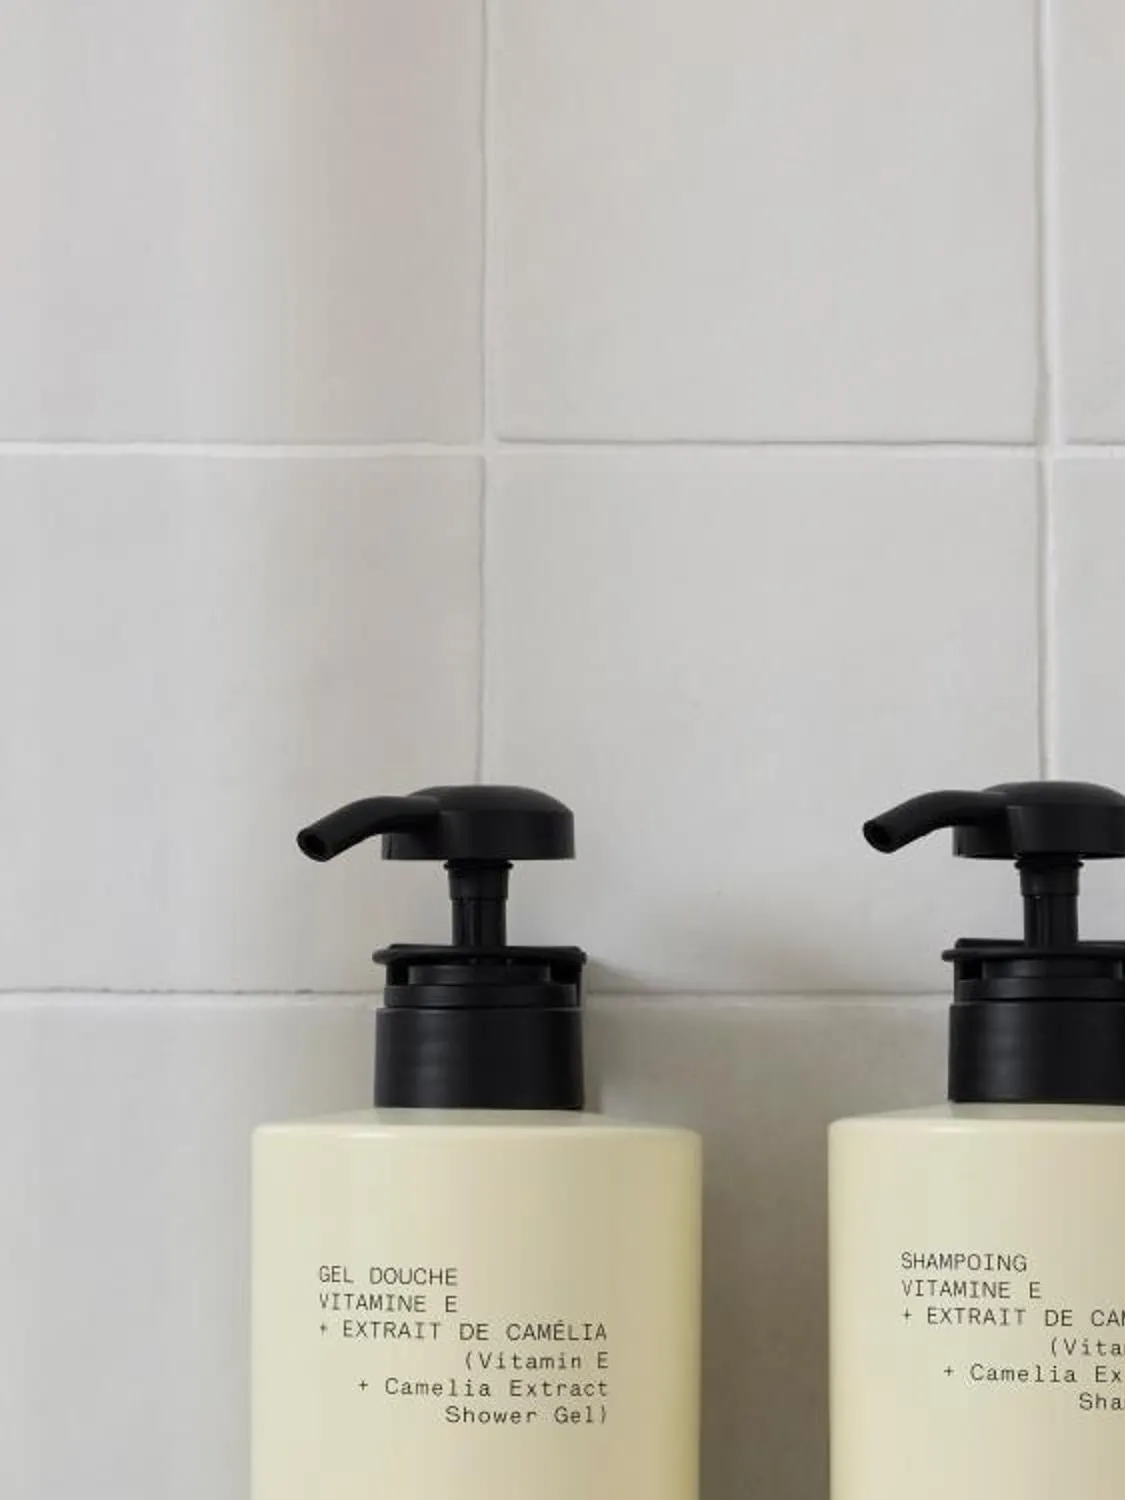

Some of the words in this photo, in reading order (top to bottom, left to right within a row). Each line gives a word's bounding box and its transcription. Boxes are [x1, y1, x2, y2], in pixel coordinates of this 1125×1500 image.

[901, 1252, 1028, 1273] SHAMPOING
[319, 1265, 354, 1285] GEL
[369, 1267, 458, 1286] DOUCHE
[902, 1279, 1011, 1300] VITAMINE
[1028, 1281, 1042, 1300] E
[320, 1293, 426, 1313] VITAMINE
[444, 1295, 458, 1313] E
[926, 1307, 1027, 1327] EXTRAIT
[1043, 1309, 1073, 1328] DE
[342, 1320, 442, 1341] EXTRAIT
[458, 1323, 489, 1341] DE
[505, 1319, 608, 1342] CAMÉLIA
[464, 1351, 582, 1372] (Vitamin
[596, 1352, 609, 1370] E
[969, 1364, 1079, 1383] Camelia
[384, 1378, 491, 1397] Camelia
[509, 1379, 608, 1398] Extract
[444, 1405, 538, 1425] Shower
[553, 1405, 608, 1425] Gel)
